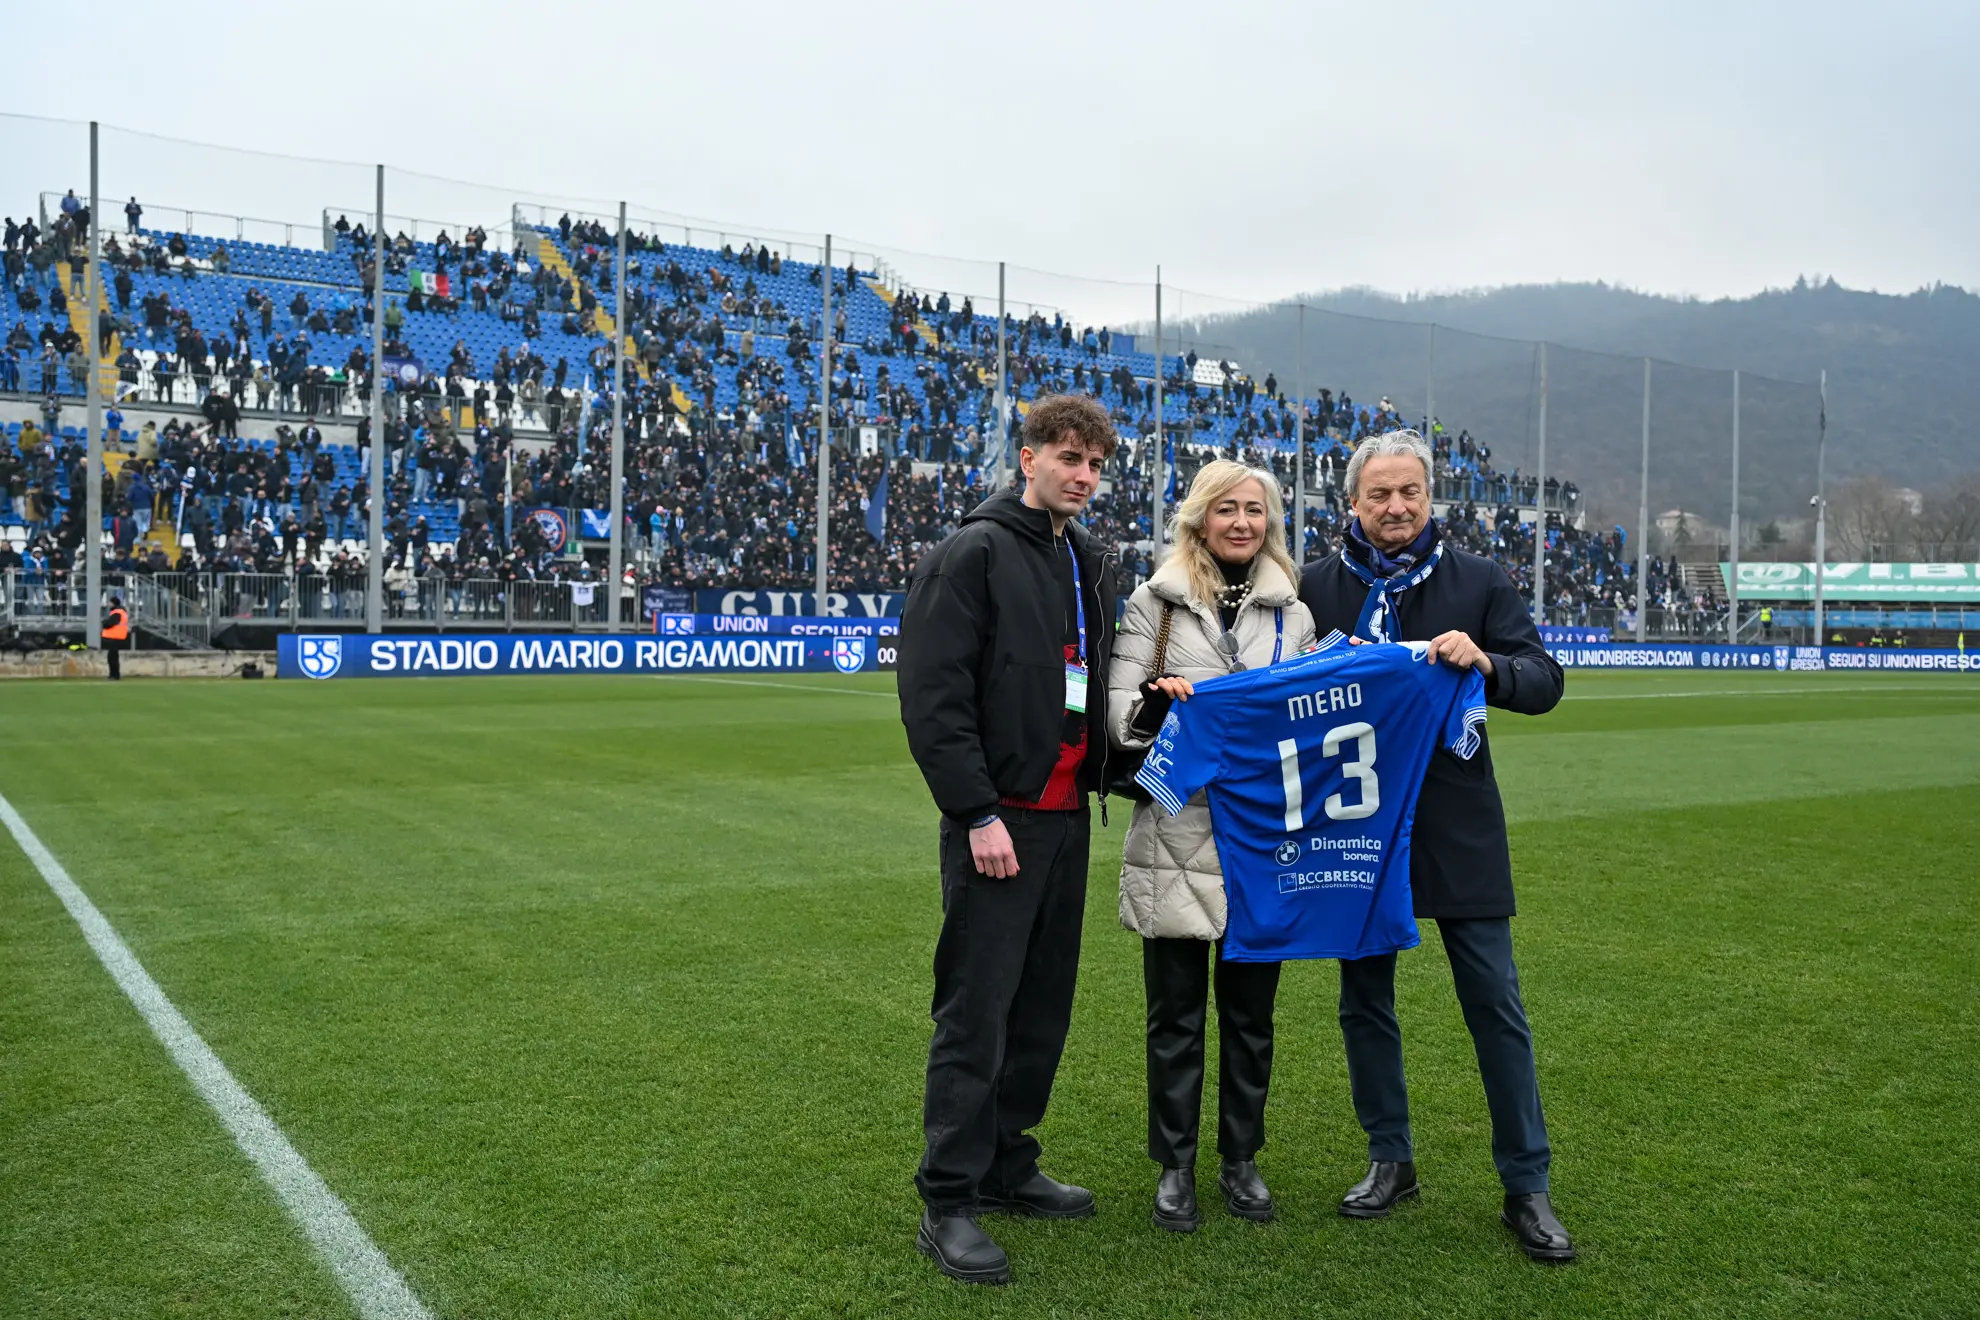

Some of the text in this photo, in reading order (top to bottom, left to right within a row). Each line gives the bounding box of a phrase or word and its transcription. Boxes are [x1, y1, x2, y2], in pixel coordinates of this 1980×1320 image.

[713, 616, 768, 633] UNION
[370, 640, 805, 671] STADIO MARIO RIGAMONTI
[1556, 649, 1574, 666] SU
[1577, 649, 1694, 667] UNIONBRESCIA.COM
[1796, 647, 1821, 659] UNION
[1828, 653, 1866, 668] SEGUICI
[1868, 653, 1882, 668] SU
[1790, 658, 1826, 671] BRESCIA
[1287, 683, 1363, 721] MERO
[1277, 721, 1380, 833] 13
[1311, 835, 1382, 851] Dinamica
